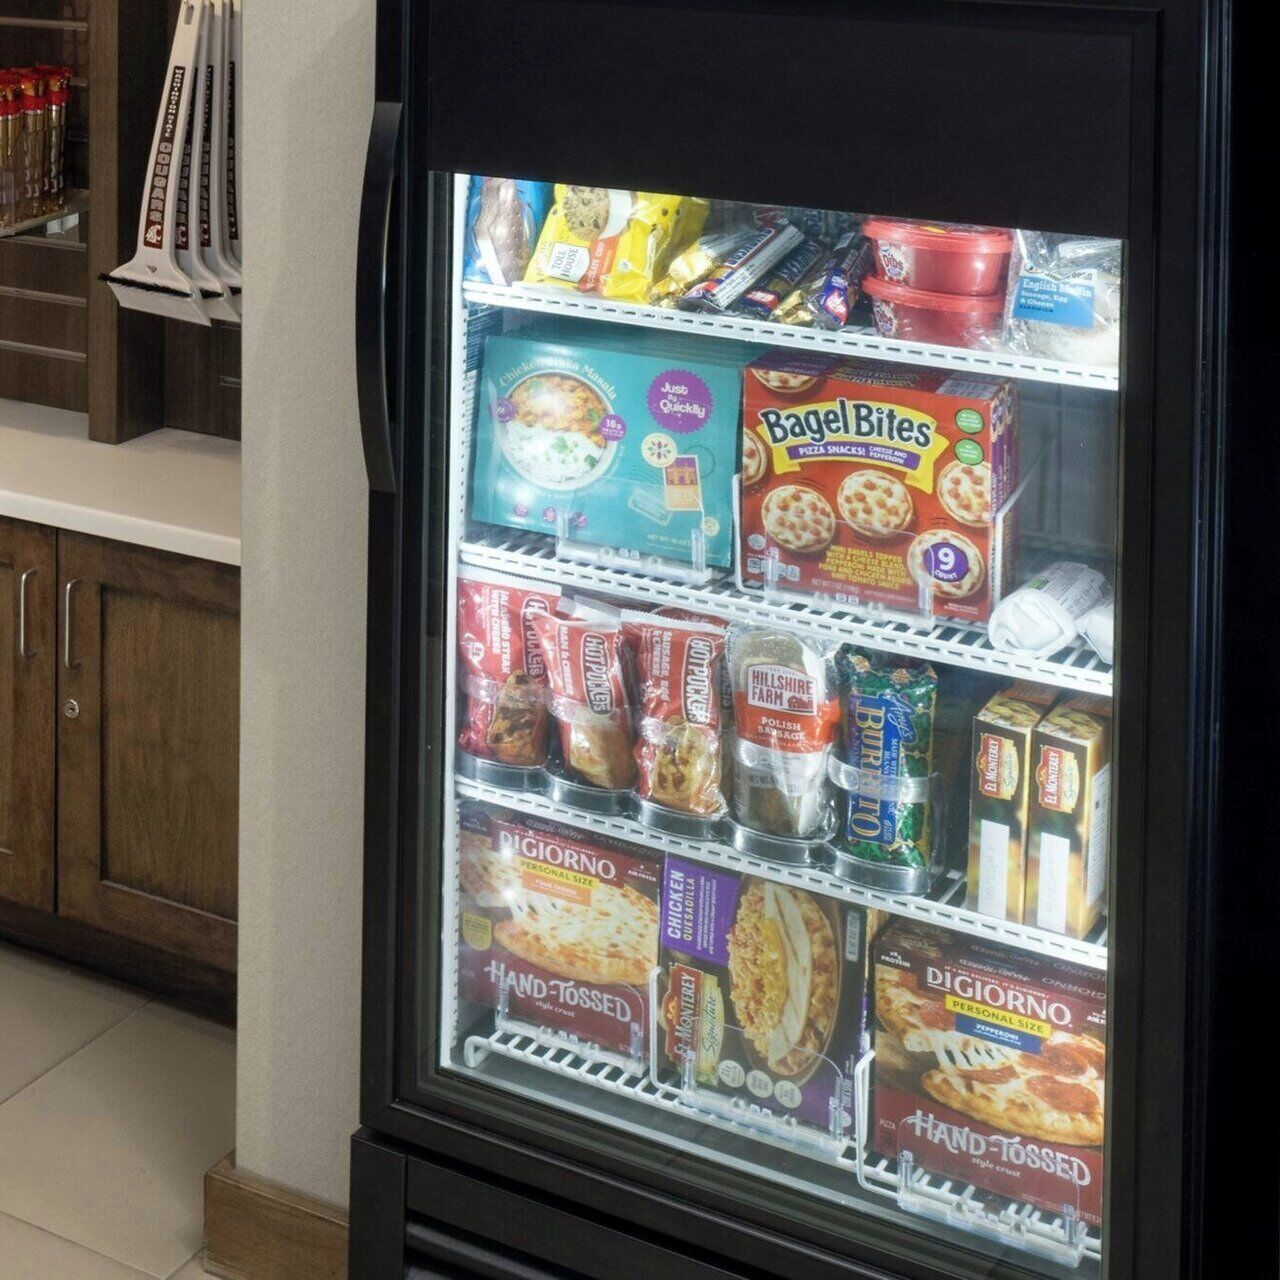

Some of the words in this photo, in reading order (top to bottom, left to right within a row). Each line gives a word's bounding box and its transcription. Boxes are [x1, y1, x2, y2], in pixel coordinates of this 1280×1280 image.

[549, 249, 567, 273] TOLL
[559, 246, 579, 280] HOUSE
[882, 255, 903, 270] Dibs
[1023, 279, 1057, 292] English
[581, 363, 618, 401] Masala
[660, 382, 689, 396] Just
[760, 398, 852, 447] Bagel
[852, 402, 933, 450] Bites
[798, 446, 826, 457] PIZZA
[937, 546, 956, 571] 9
[751, 668, 813, 697] HILLSHIRE
[751, 684, 784, 708] FARM
[760, 715, 802, 732] POLISH
[886, 697, 913, 740] Amy's
[984, 737, 1001, 780] MONTEREY
[1047, 750, 1060, 793] MONTEREY
[500, 830, 617, 880] DIGIORNO
[519, 860, 572, 886] PERSONAL
[572, 871, 595, 888] SIZE
[668, 869, 684, 940] CHICKEN
[683, 877, 696, 942] QUESADILLA
[880, 953, 912, 969] PROTEIN
[484, 959, 632, 1023] HAND-TOSSED
[674, 973, 697, 1041] MONTEREY
[926, 966, 1073, 1028] DIGIORNO
[701, 995, 718, 1058] Signature
[952, 999, 1016, 1026] PERSONAL
[1017, 1018, 1045, 1035] SIZE
[975, 1023, 1020, 1041] PEPPERONI
[906, 1108, 1092, 1187] HAND-TOSSED
[971, 1156, 995, 1172] style
[996, 1163, 1022, 1179] crust
